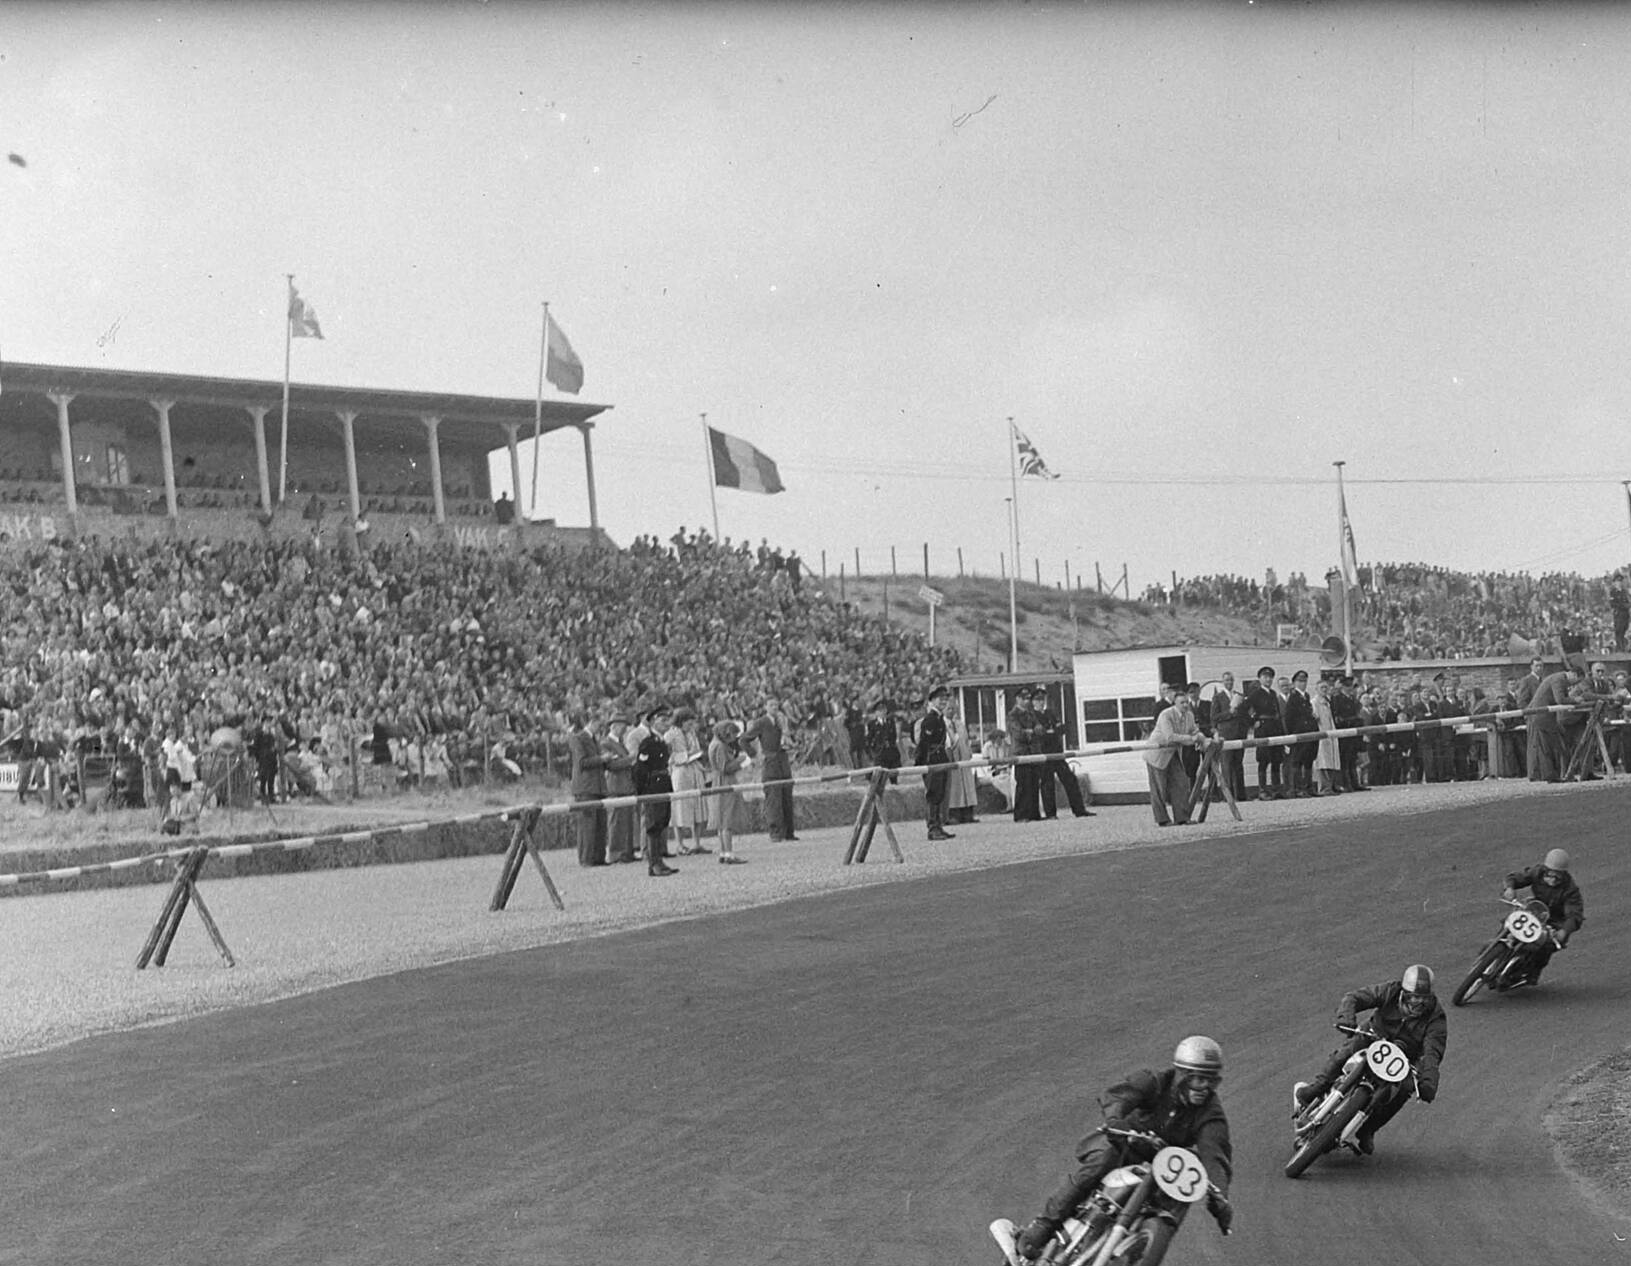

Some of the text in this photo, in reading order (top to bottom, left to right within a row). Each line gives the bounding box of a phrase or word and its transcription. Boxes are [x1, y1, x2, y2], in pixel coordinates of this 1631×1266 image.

[1512, 914, 1539, 938] 85
[1372, 1044, 1404, 1077] 80
[1160, 1154, 1202, 1197] 93
